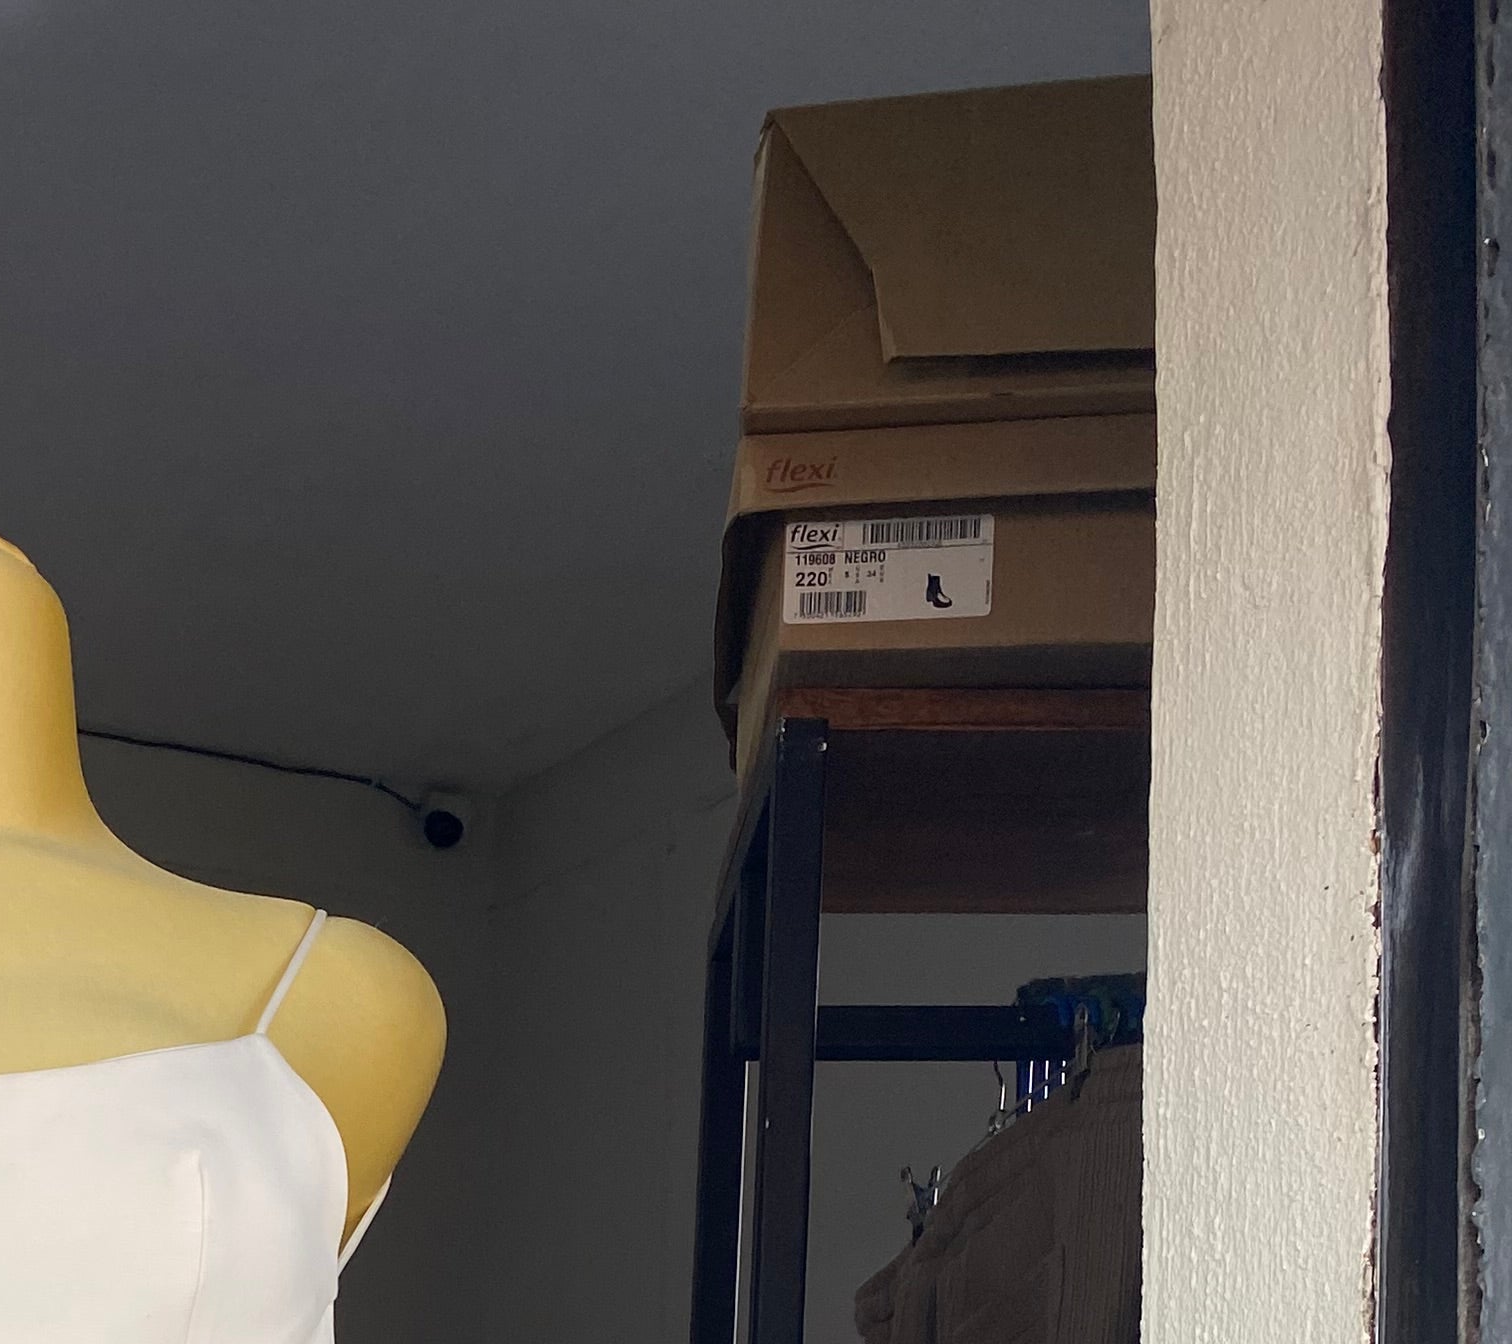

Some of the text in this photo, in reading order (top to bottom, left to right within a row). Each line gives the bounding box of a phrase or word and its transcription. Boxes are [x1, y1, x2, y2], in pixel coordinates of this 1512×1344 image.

[766, 456, 838, 483] flexi
[790, 523, 840, 543] flexi
[795, 551, 886, 566] 119608 NEGRO
[795, 571, 828, 588] 220
